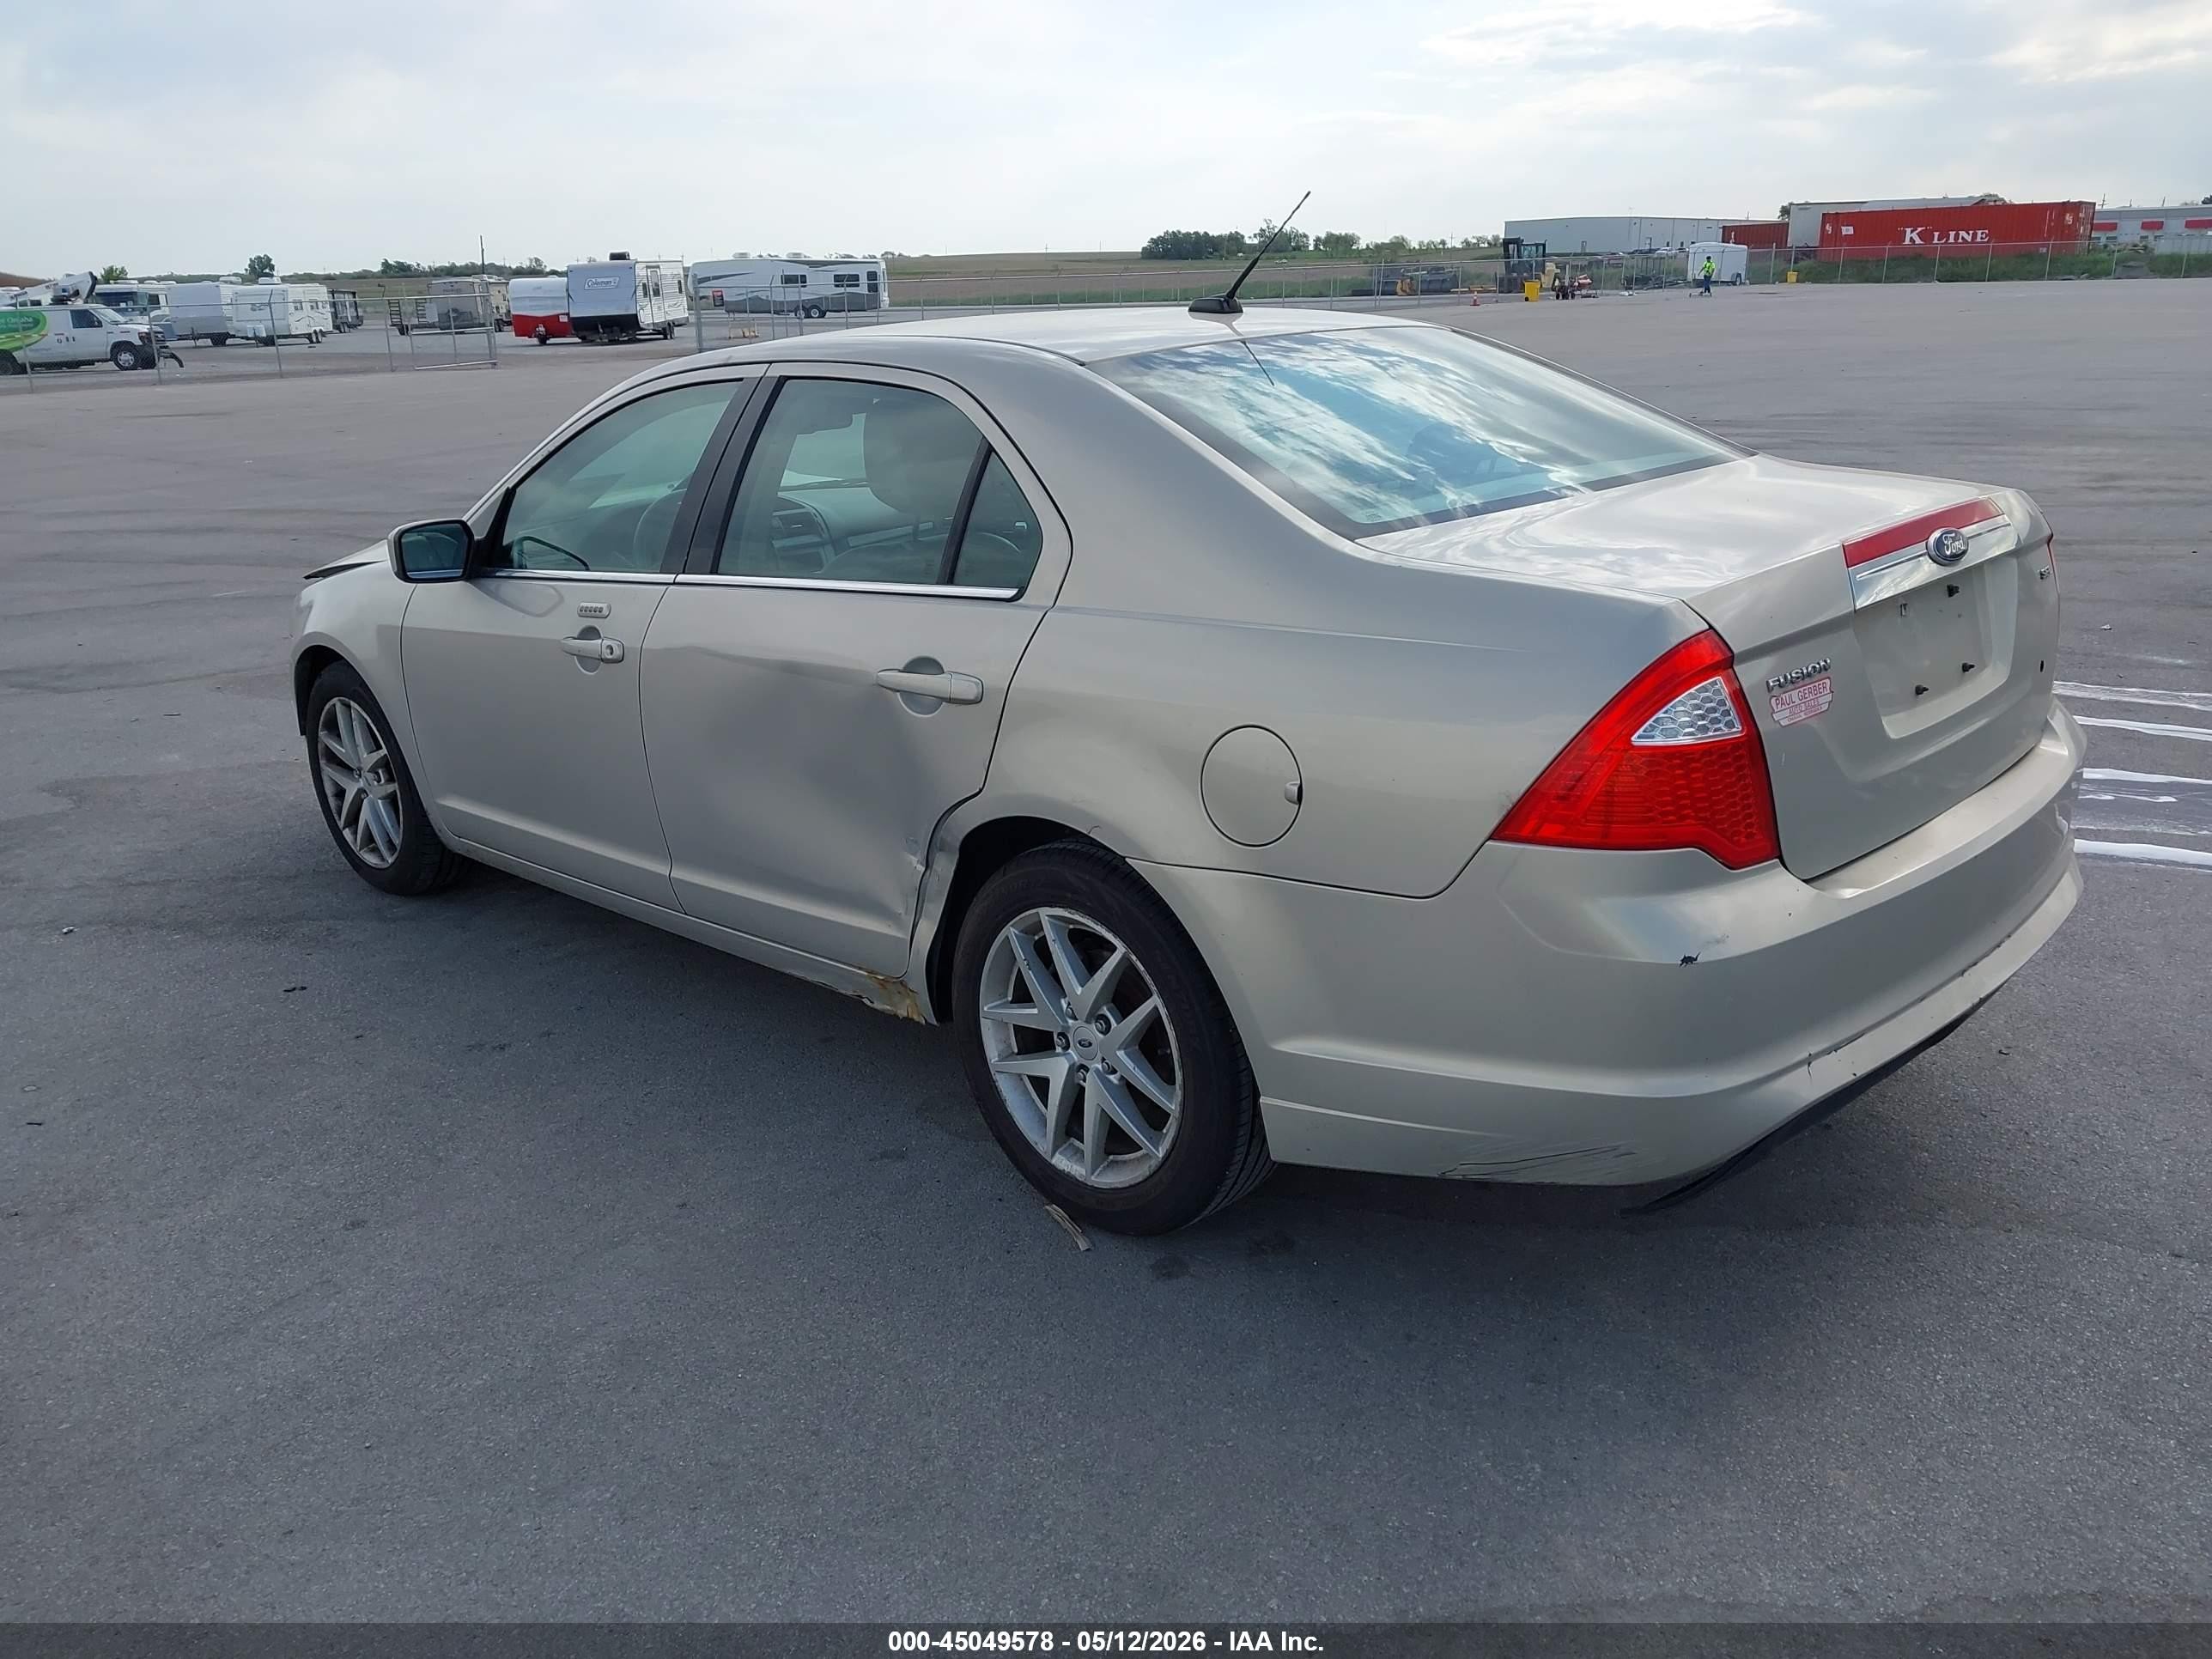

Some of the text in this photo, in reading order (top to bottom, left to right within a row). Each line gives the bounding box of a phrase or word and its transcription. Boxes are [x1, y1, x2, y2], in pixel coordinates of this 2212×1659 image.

[1933, 229, 1990, 244] LINE
[1942, 532, 1966, 555] Ford
[1766, 658, 1831, 693] FUSION
[1775, 681, 1828, 710] PAUL GERBER
[1789, 698, 1820, 715] AUTO SALES
